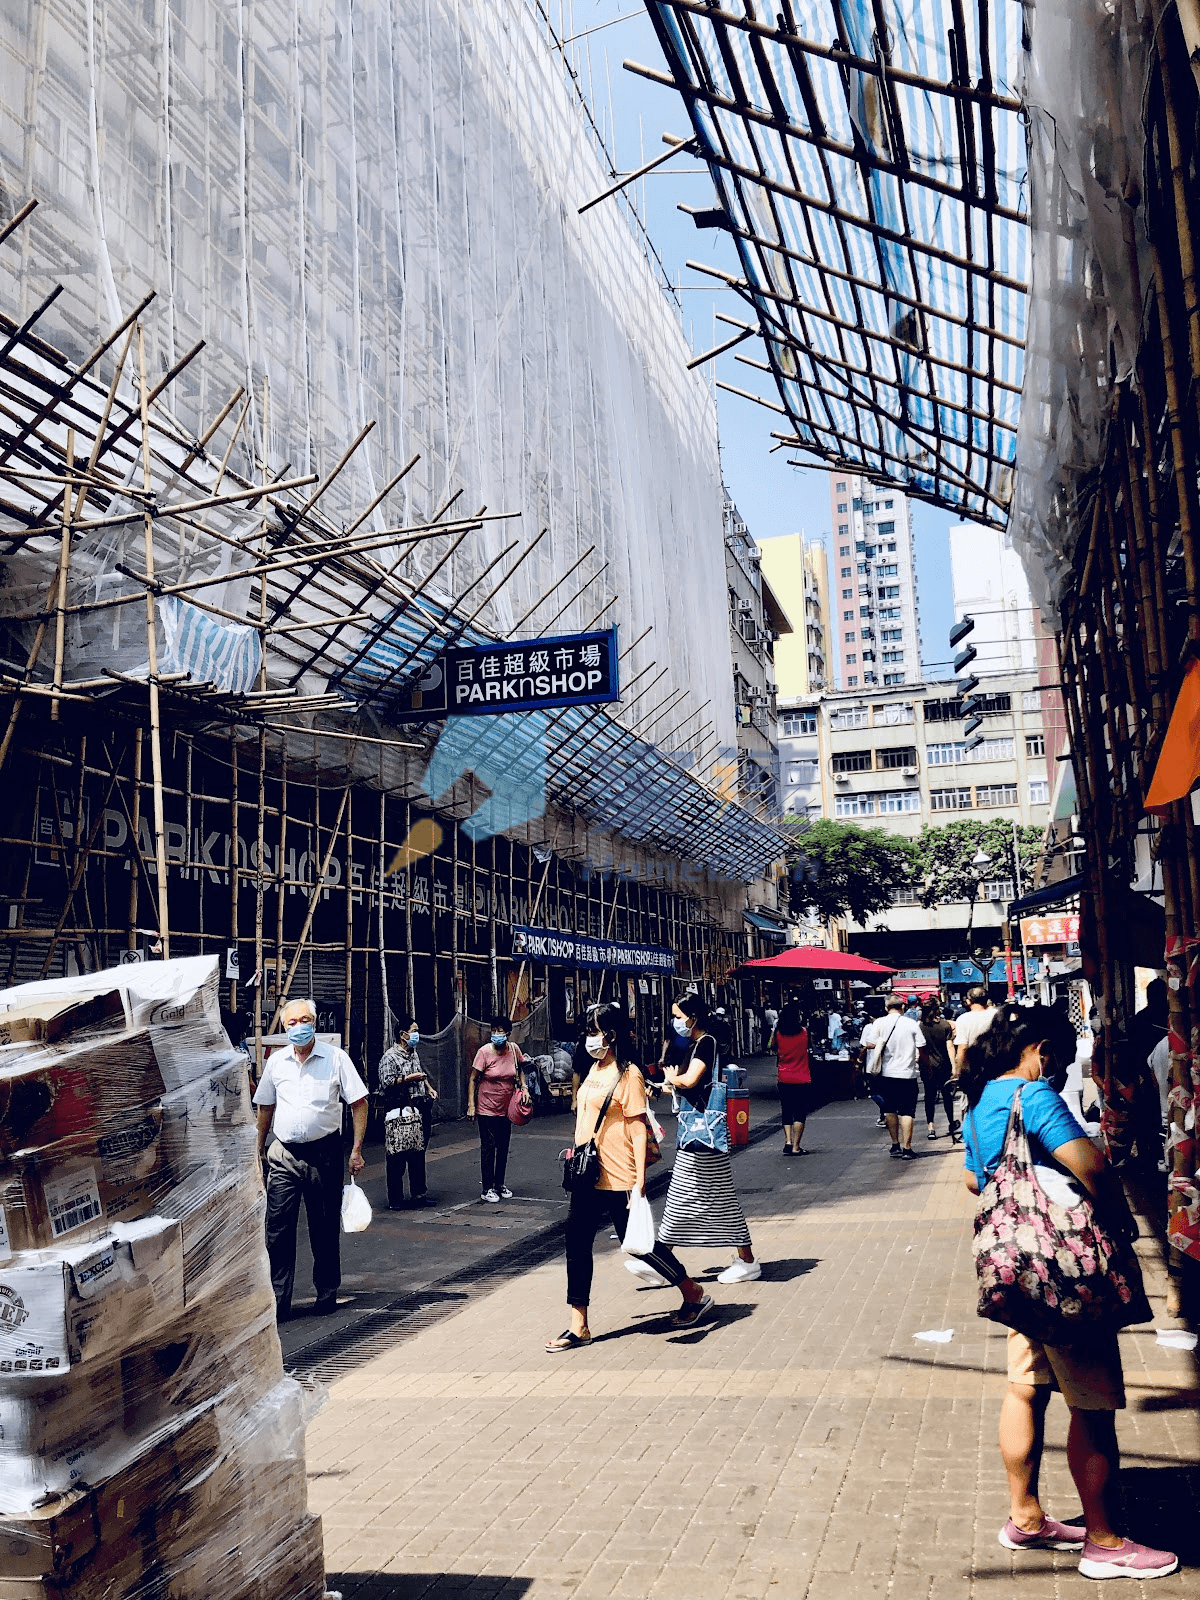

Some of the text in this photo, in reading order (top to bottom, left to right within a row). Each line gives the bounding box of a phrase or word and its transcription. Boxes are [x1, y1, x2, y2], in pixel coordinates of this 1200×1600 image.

[455, 644, 602, 681] 百佳超級市場
[160, 1004, 186, 1021] Gold
[78, 1255, 114, 1284] EXCEL
